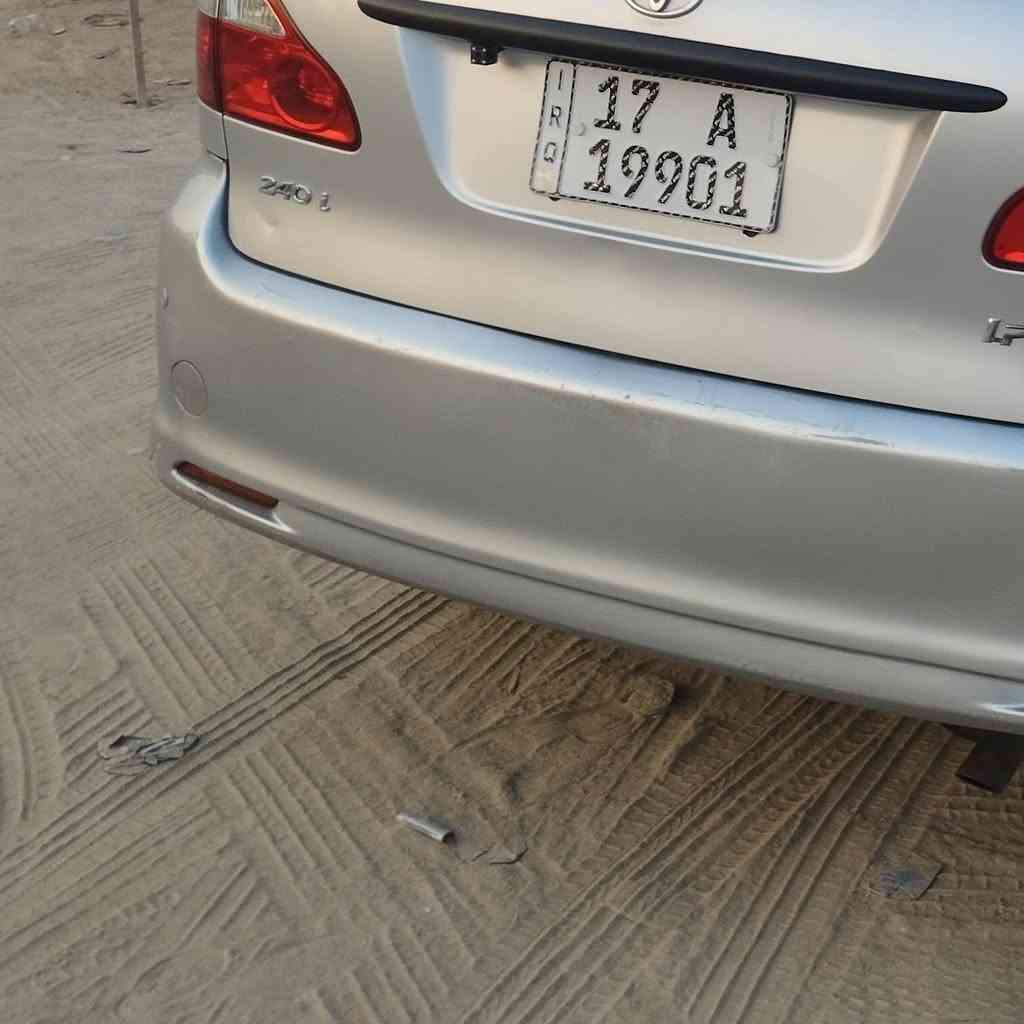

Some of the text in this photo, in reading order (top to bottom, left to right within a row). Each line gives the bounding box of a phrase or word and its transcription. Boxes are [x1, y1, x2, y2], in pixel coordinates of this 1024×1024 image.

[593, 75, 737, 150] 17 A
[583, 138, 748, 218] 19901
